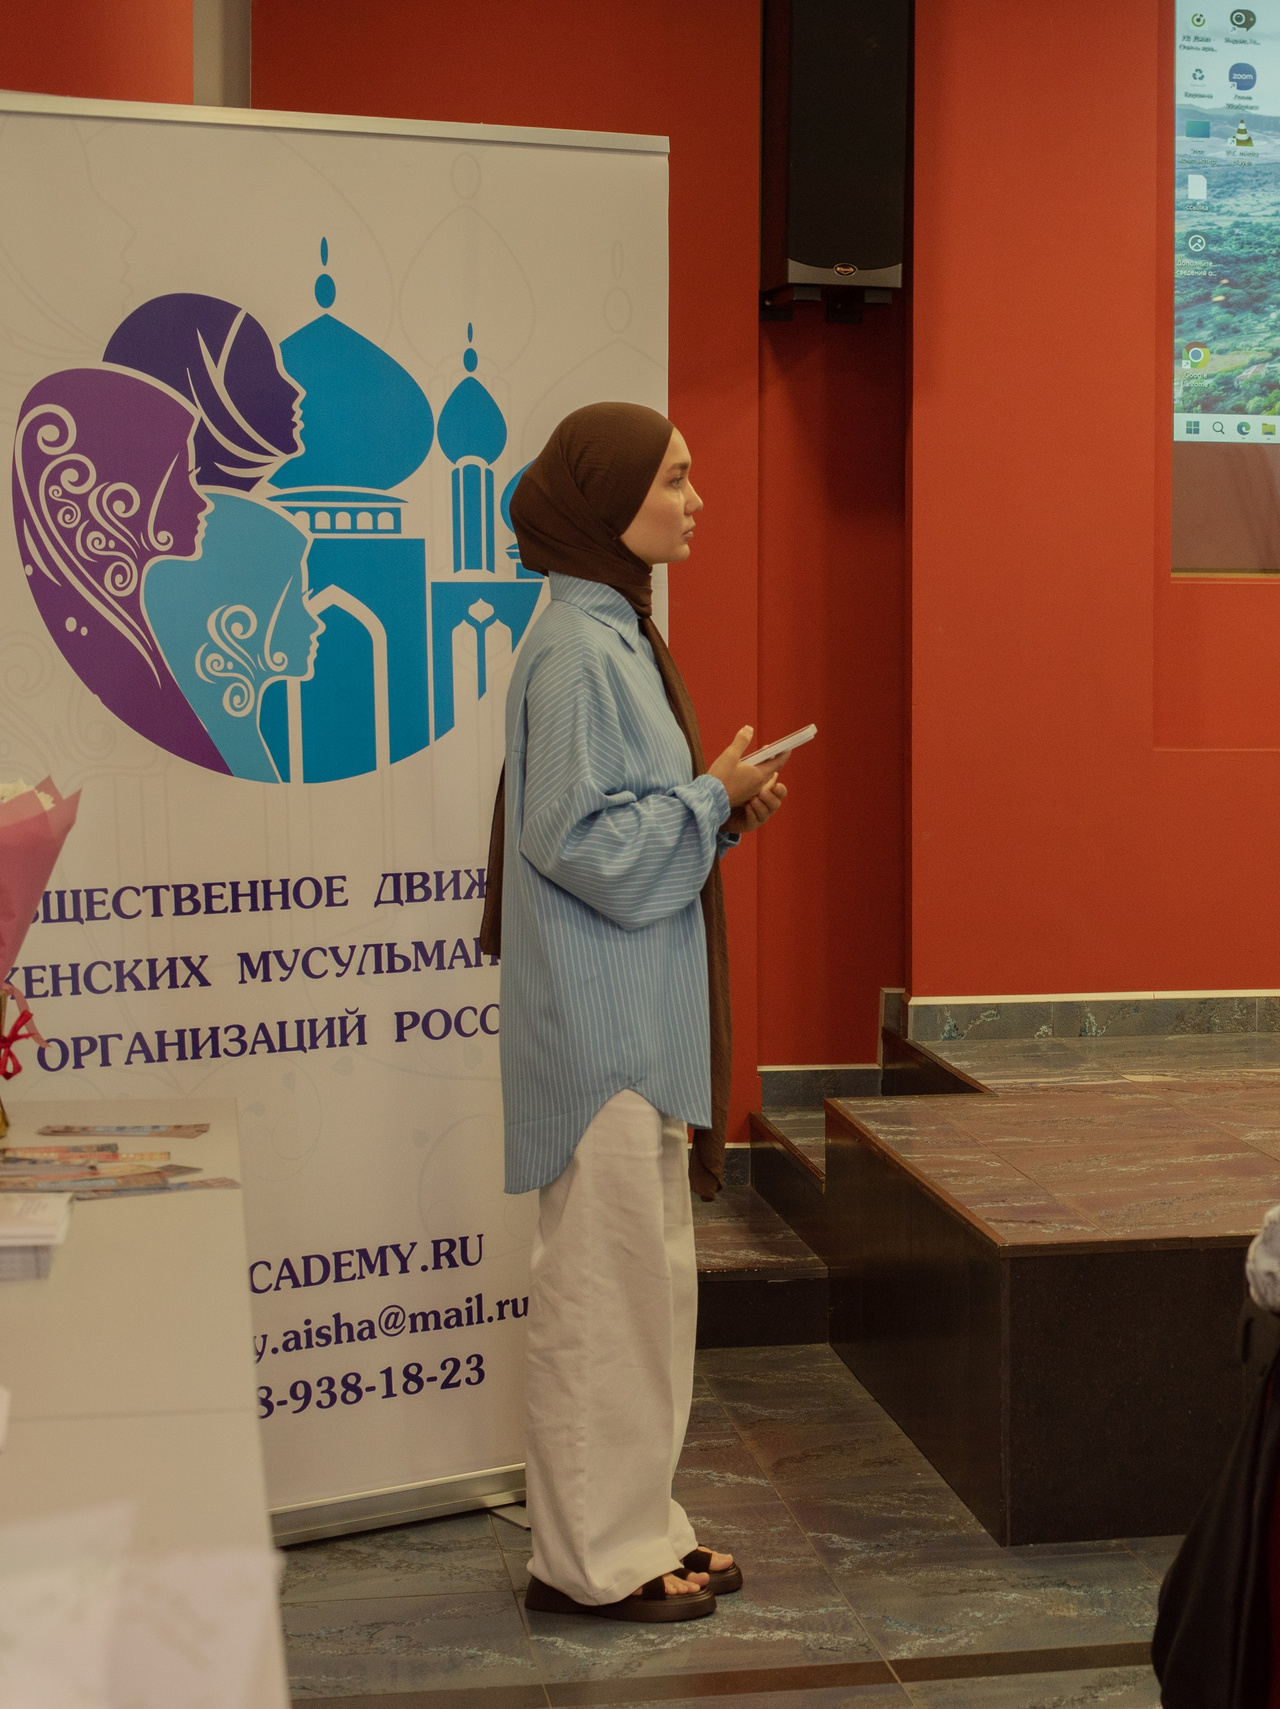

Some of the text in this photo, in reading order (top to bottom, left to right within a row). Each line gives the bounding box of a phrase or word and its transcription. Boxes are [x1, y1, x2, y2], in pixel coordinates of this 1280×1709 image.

[31, 874, 349, 926] ЩЕСТВЕННОЕ
[37, 1007, 367, 1072] ОРГАНИЗАЦИЙ
[249, 1234, 484, 1294] CADEMY.RU
[253, 1293, 529, 1364] y.aisha@mail.ru
[257, 1353, 486, 1420] 8-938-18-23
